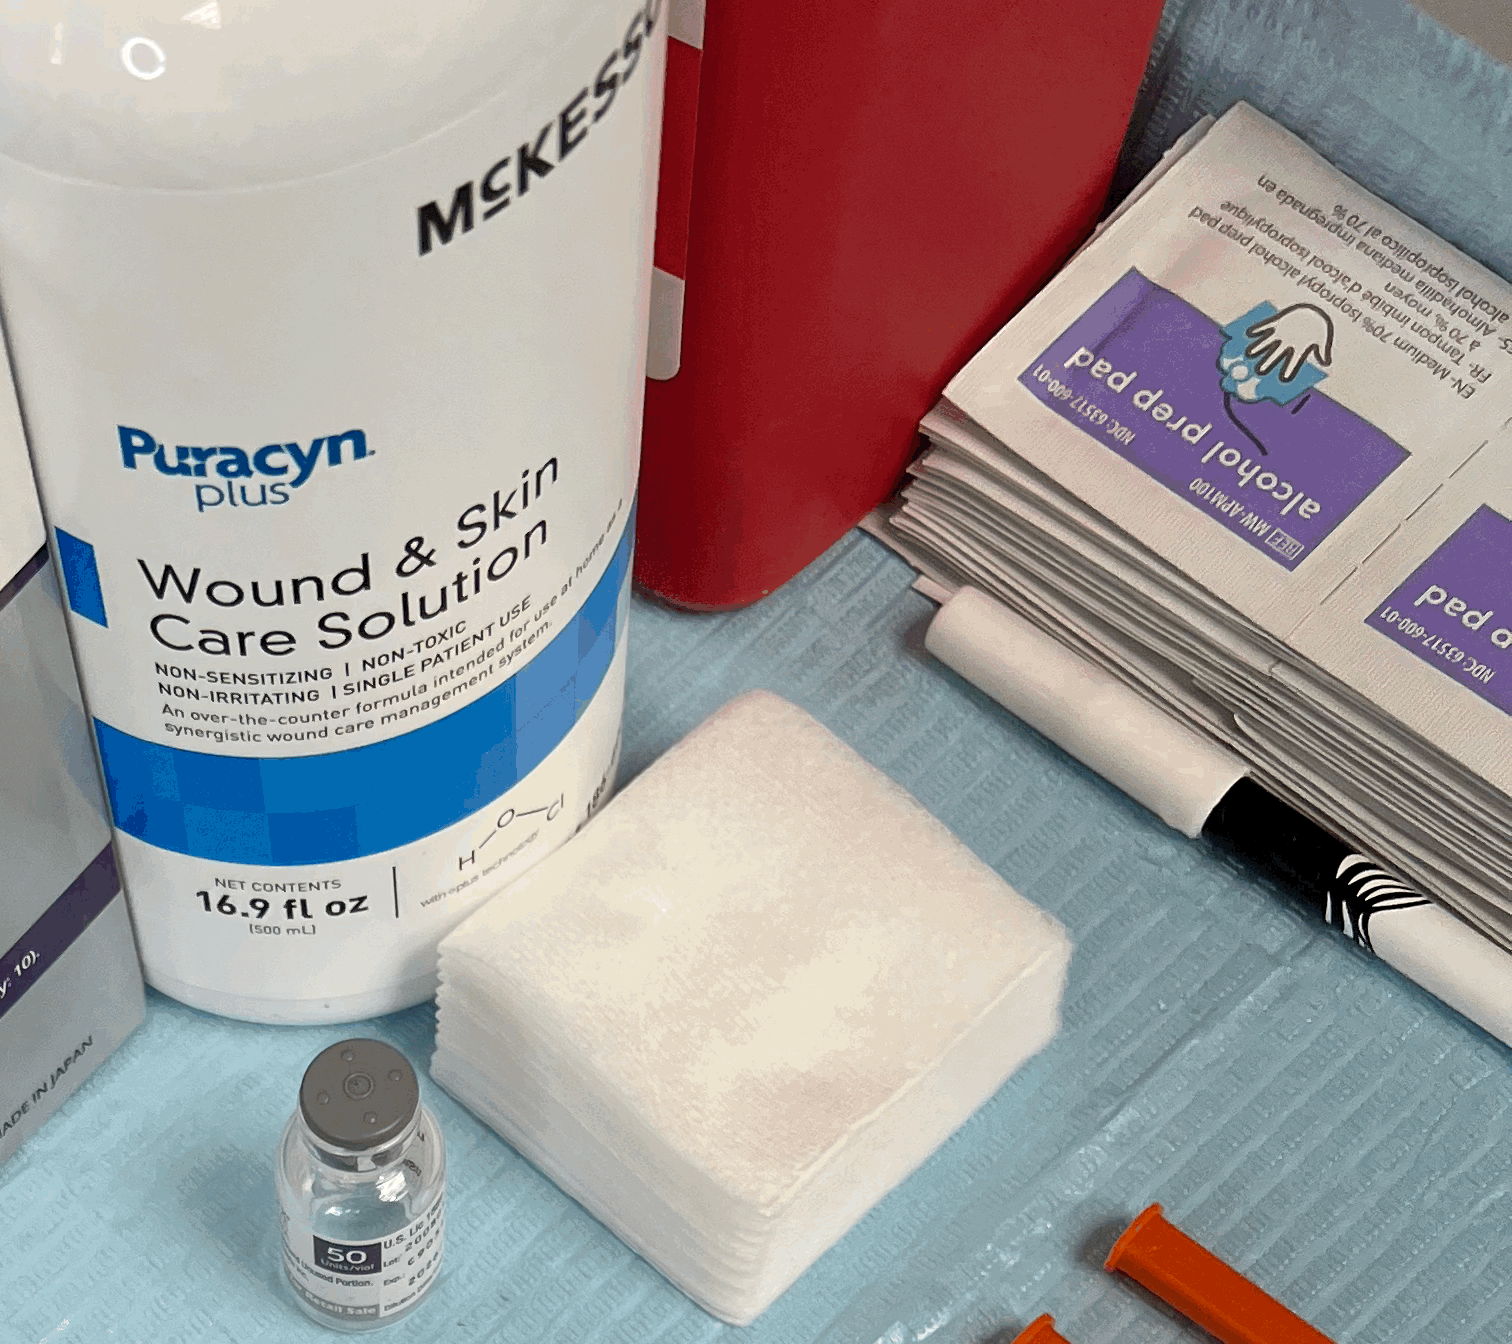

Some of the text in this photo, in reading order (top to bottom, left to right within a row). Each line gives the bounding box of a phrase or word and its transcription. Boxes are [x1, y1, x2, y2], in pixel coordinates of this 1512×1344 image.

[1257, 174, 1497, 337] Almohadilla mediana en
[1255, 241, 1451, 382] Medium alcohol
[1384, 281, 1433, 315] moyen
[1457, 286, 1509, 323] alcohol
[1411, 322, 1465, 367] Tampon
[1033, 363, 1109, 426] 63517-600-01
[117, 424, 369, 488] Puracyn
[1063, 346, 1322, 520] alcohol prep pad
[195, 481, 291, 513] plus
[137, 457, 558, 607] Wound & Skin
[150, 520, 547, 657] Care Solution
[1413, 585, 1494, 630] pad
[154, 621, 467, 685] NON-SENSITIZING NON-TOXIC
[158, 595, 531, 705] NON-IRRITATING SINGLE PATIENT USE
[162, 595, 558, 726] An over-the-counter formula intended for use
[1380, 606, 1465, 663] 63517-600-01
[165, 665, 493, 743] synergistic wound care management
[197, 890, 369, 919] 16.9 fl oz
[214, 877, 342, 893] NET CONTENTS
[32, 1082, 48, 1104] IN
[50, 1035, 93, 1089] JAPAN
[327, 1247, 367, 1264] 50
